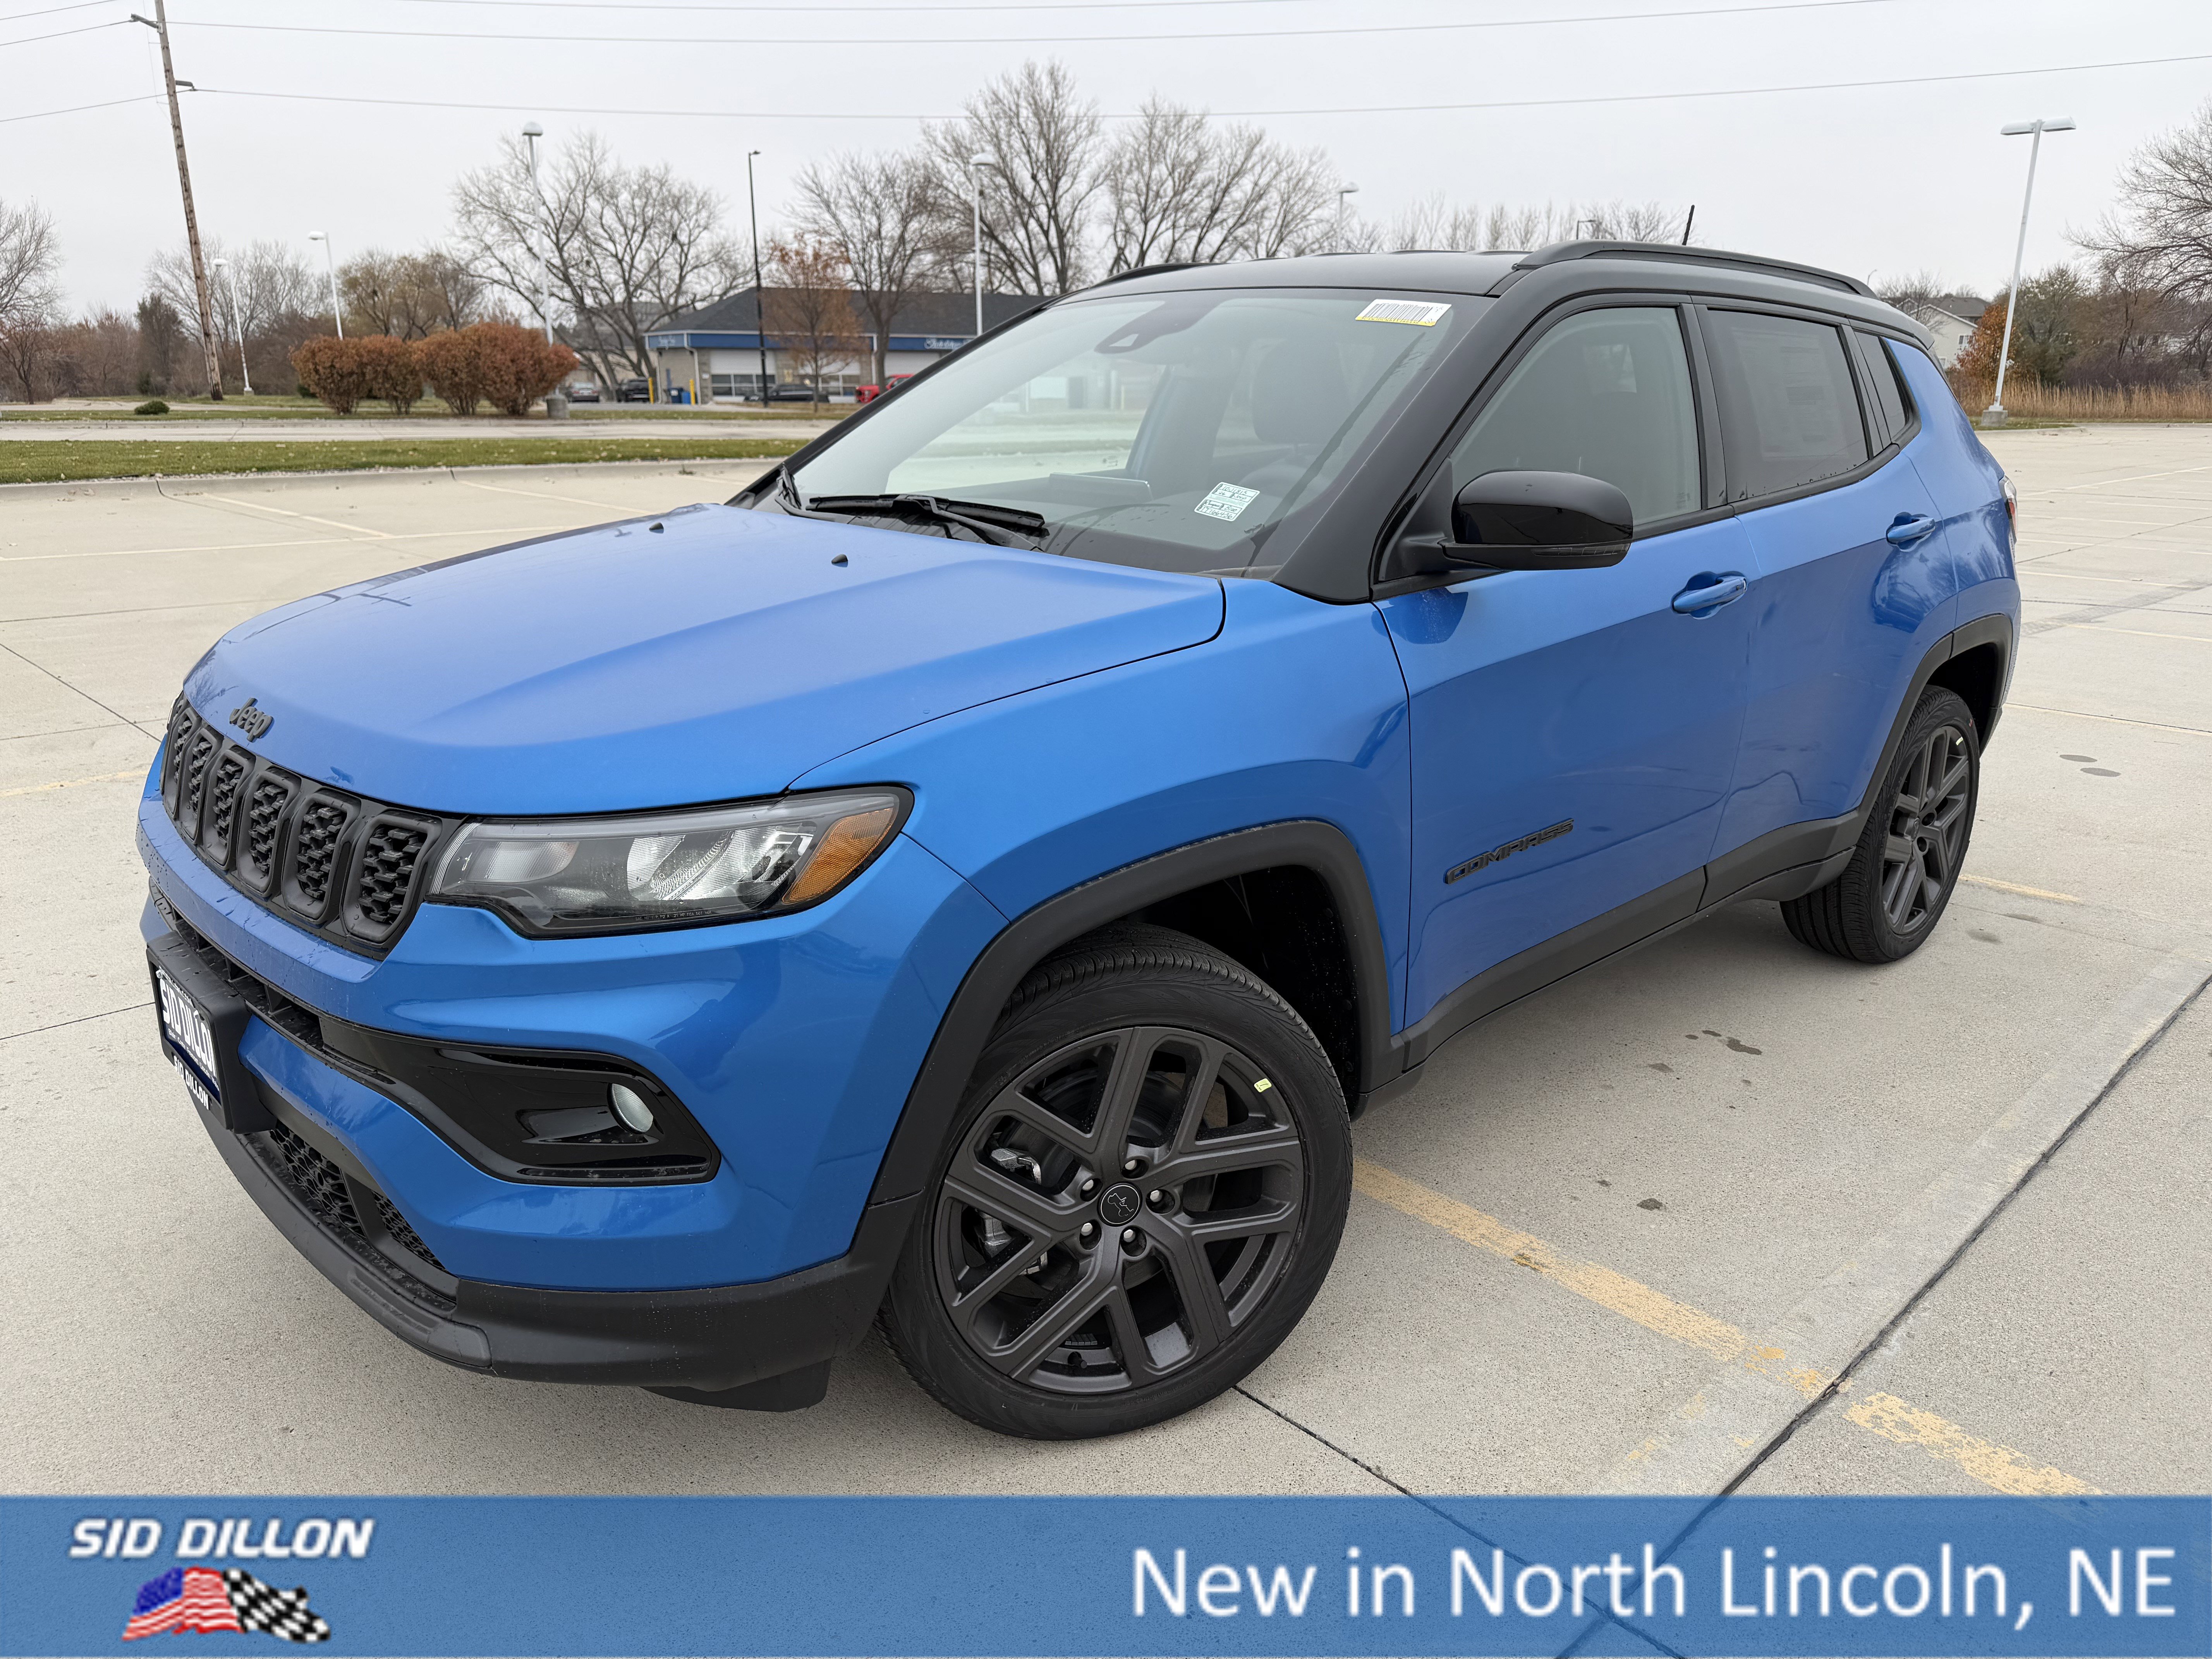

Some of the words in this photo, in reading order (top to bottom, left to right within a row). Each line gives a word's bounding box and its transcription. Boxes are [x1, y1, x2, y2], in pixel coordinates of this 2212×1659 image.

[229, 697, 274, 742] Jeep
[1444, 818, 1574, 884] COMPASS
[159, 978, 182, 1036] SID
[173, 1055, 184, 1080] SID
[185, 1068, 209, 1110] DILLON
